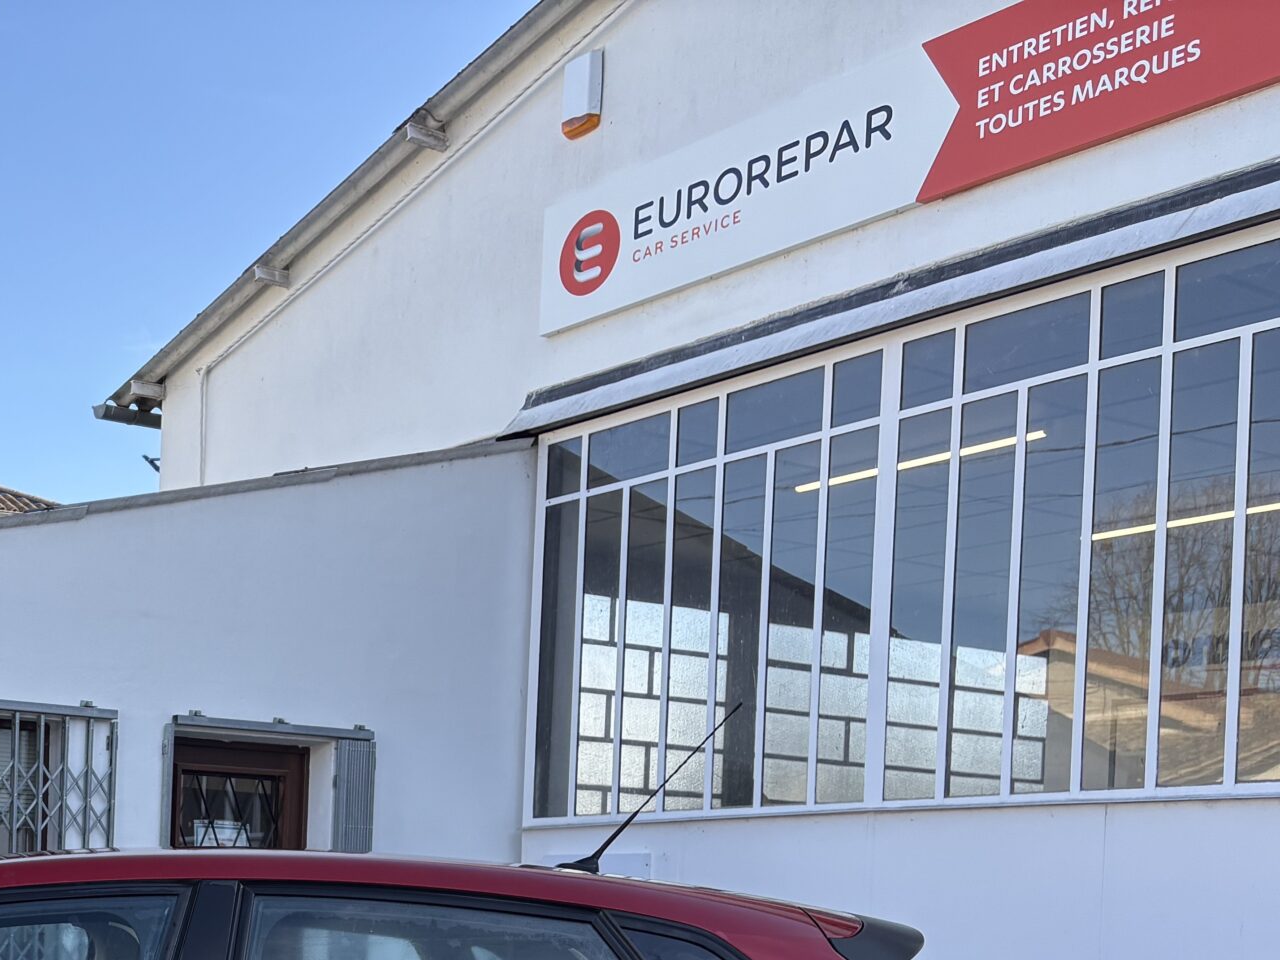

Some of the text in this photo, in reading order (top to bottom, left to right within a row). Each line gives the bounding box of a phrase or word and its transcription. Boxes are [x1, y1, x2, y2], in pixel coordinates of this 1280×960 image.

[976, 39, 1201, 139] TOUTES MARQUES
[977, 14, 1175, 109] ET CARROSSERIE
[978, 8, 1114, 77] ENTRETIEN,
[633, 104, 893, 240] EUROREPAR
[632, 209, 742, 263] CAR SERVICE
